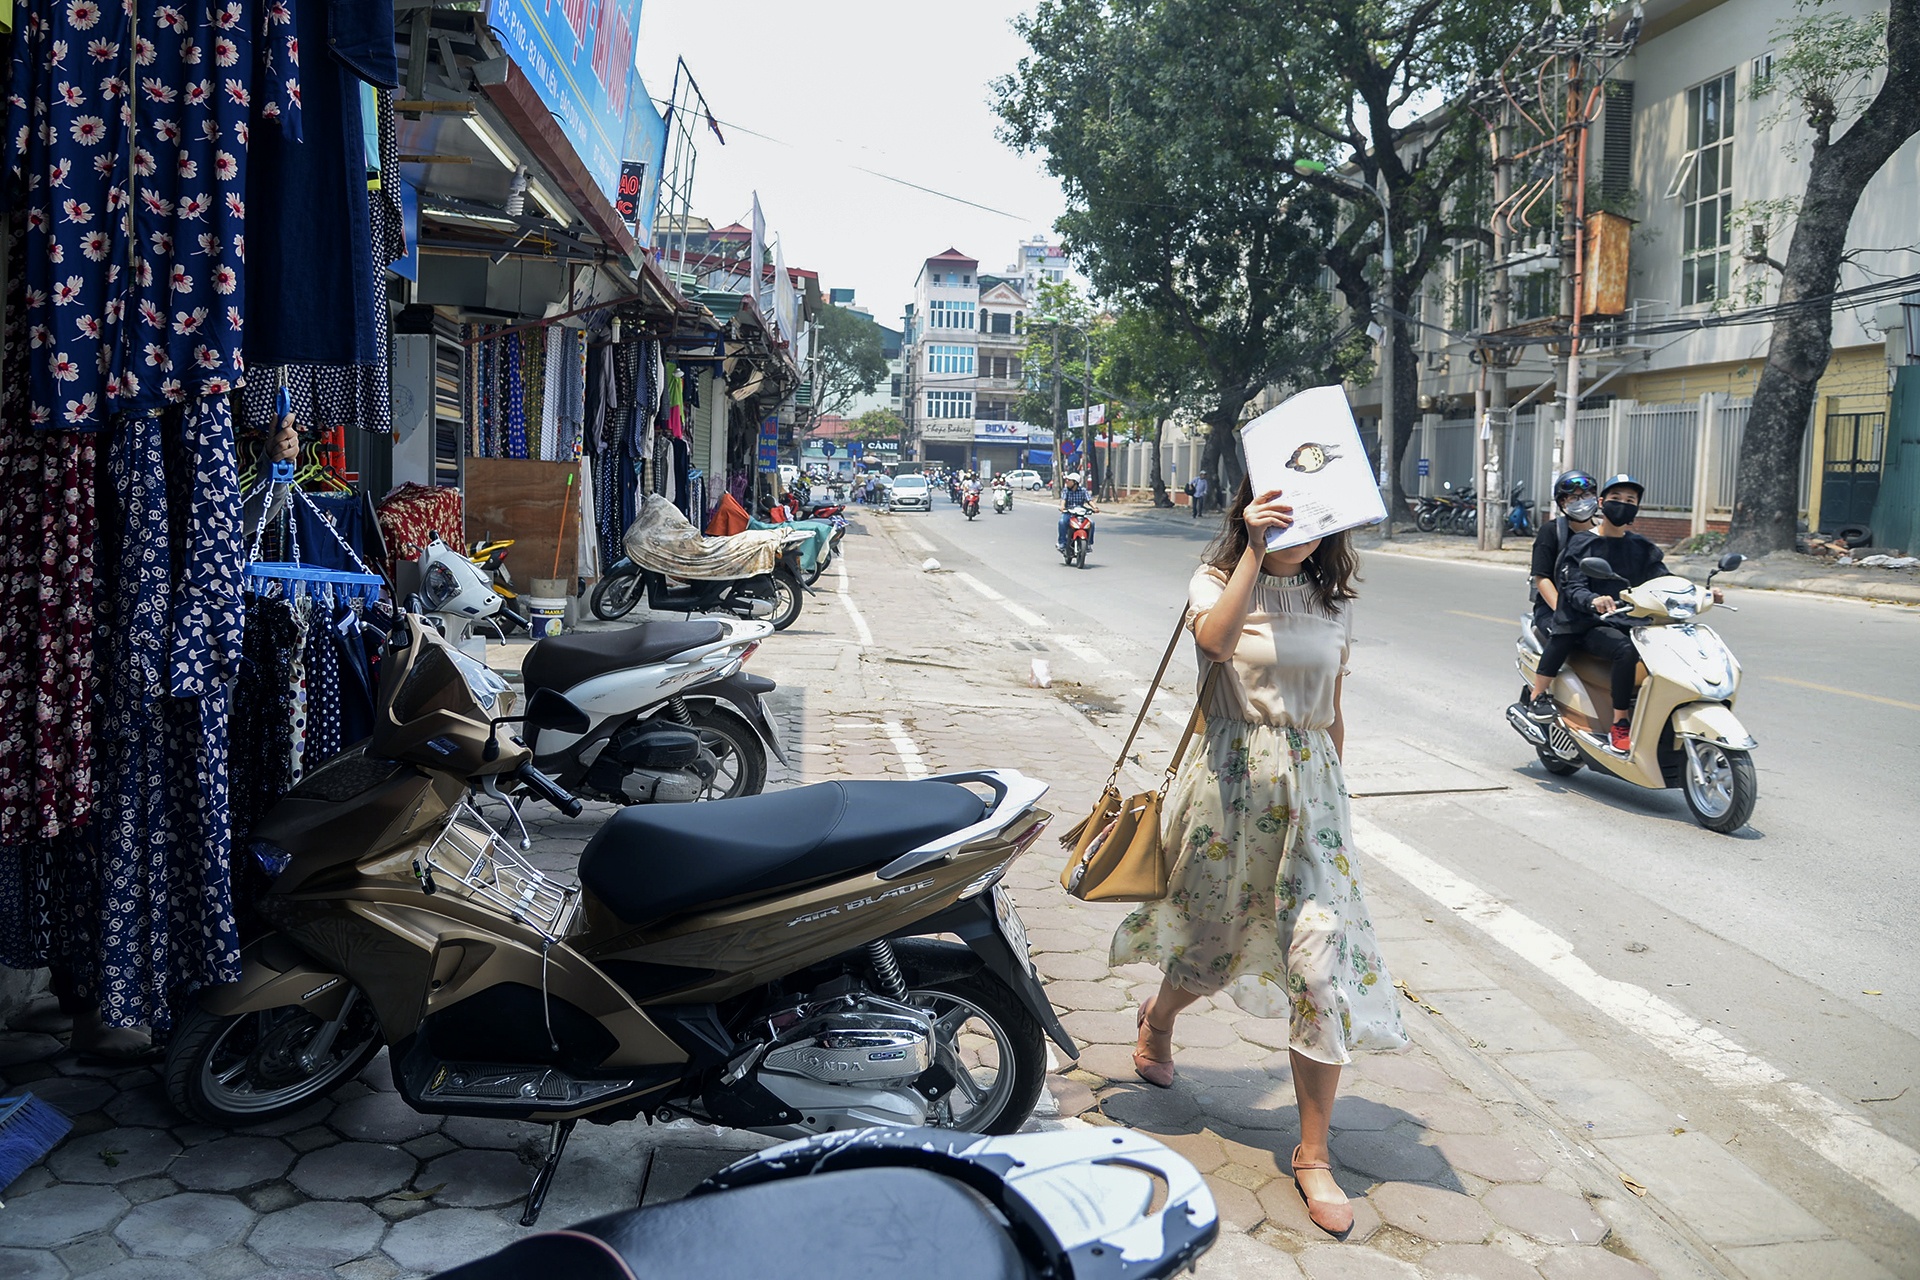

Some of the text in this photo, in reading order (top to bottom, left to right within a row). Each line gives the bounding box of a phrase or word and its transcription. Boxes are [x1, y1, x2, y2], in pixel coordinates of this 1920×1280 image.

[985, 424, 1008, 433] BIDV
[787, 877, 936, 928] AIR BLADE
[795, 1050, 864, 1071] HONDA
